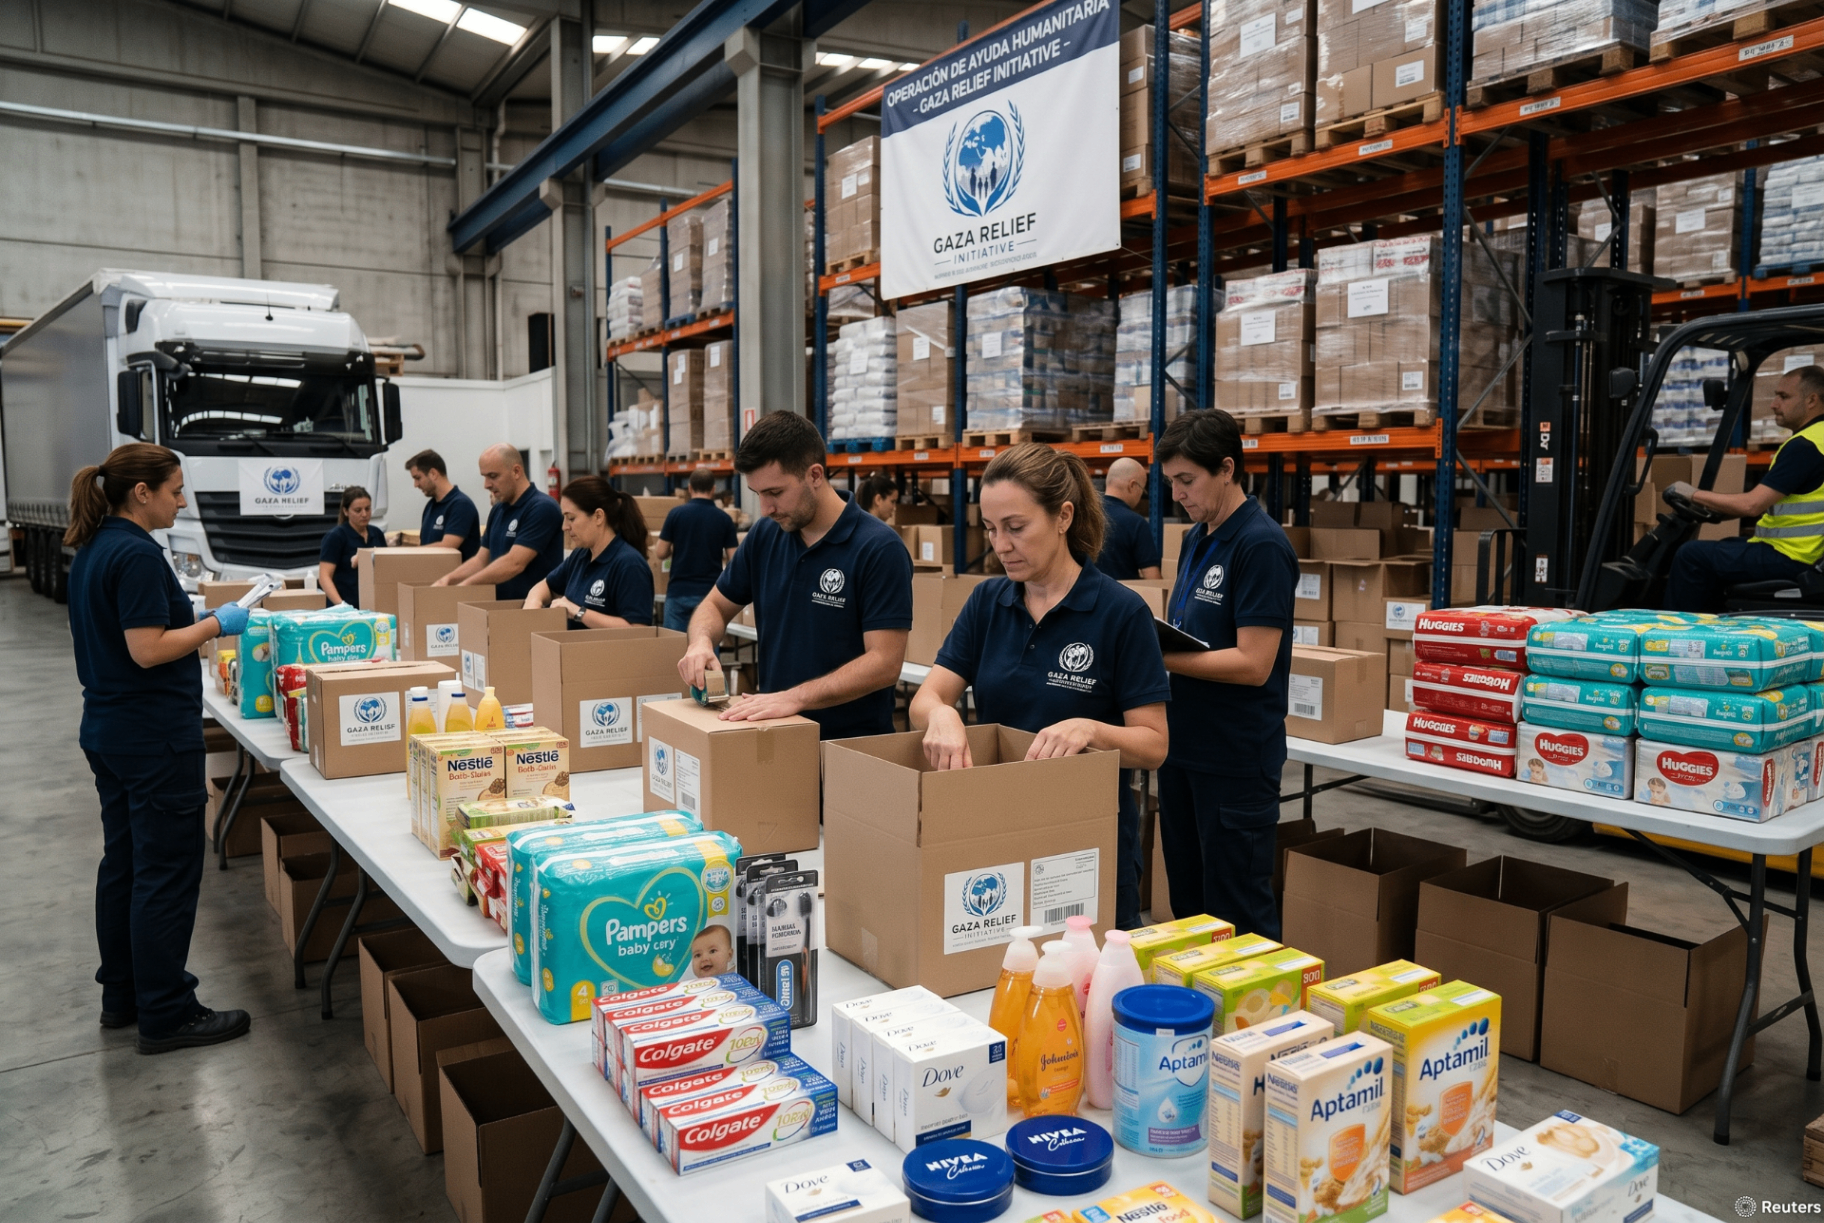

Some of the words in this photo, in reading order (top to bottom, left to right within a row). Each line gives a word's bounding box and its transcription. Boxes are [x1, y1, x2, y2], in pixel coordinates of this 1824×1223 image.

[887, 65, 949, 108] OPERACIÓN
[951, 61, 967, 79] DE
[968, 39, 1010, 71] AYUDA
[1012, 0, 1110, 51] HUMANITARIA
[919, 91, 950, 114] GAZA
[951, 68, 992, 101] RELIEF
[993, 38, 1061, 82] INITIATIVE
[934, 230, 975, 254] GAZA
[980, 212, 1036, 243] RELIEF
[954, 240, 1015, 265] INITIATIVE
[1418, 618, 1465, 632] HUGGIES
[321, 641, 367, 657] Pampers
[585, 728, 604, 736] GAZA
[1539, 738, 1584, 757] HUGGIES
[1661, 757, 1714, 777] HUGGIES
[605, 917, 688, 945] Pampers
[952, 922, 980, 934] GAZA
[983, 914, 1017, 928] RELIEF
[618, 942, 650, 957] baby
[577, 985, 588, 997] 4
[598, 986, 668, 1003] Colgate
[612, 1000, 684, 1018] Colgate
[629, 1014, 702, 1033] Colgate
[639, 1037, 715, 1063] Colgate
[1419, 1036, 1489, 1081] Aptamil
[649, 1071, 724, 1095] Colgate
[922, 1065, 964, 1088] Dove
[667, 1090, 743, 1116] Colgate
[1311, 1076, 1384, 1122] Aptamil
[684, 1115, 761, 1145] Colgate
[1027, 1127, 1087, 1144] NIVEA
[925, 1152, 988, 1172] NIVEA
[1480, 1144, 1531, 1173] Dove
[781, 1175, 830, 1194] Dove
